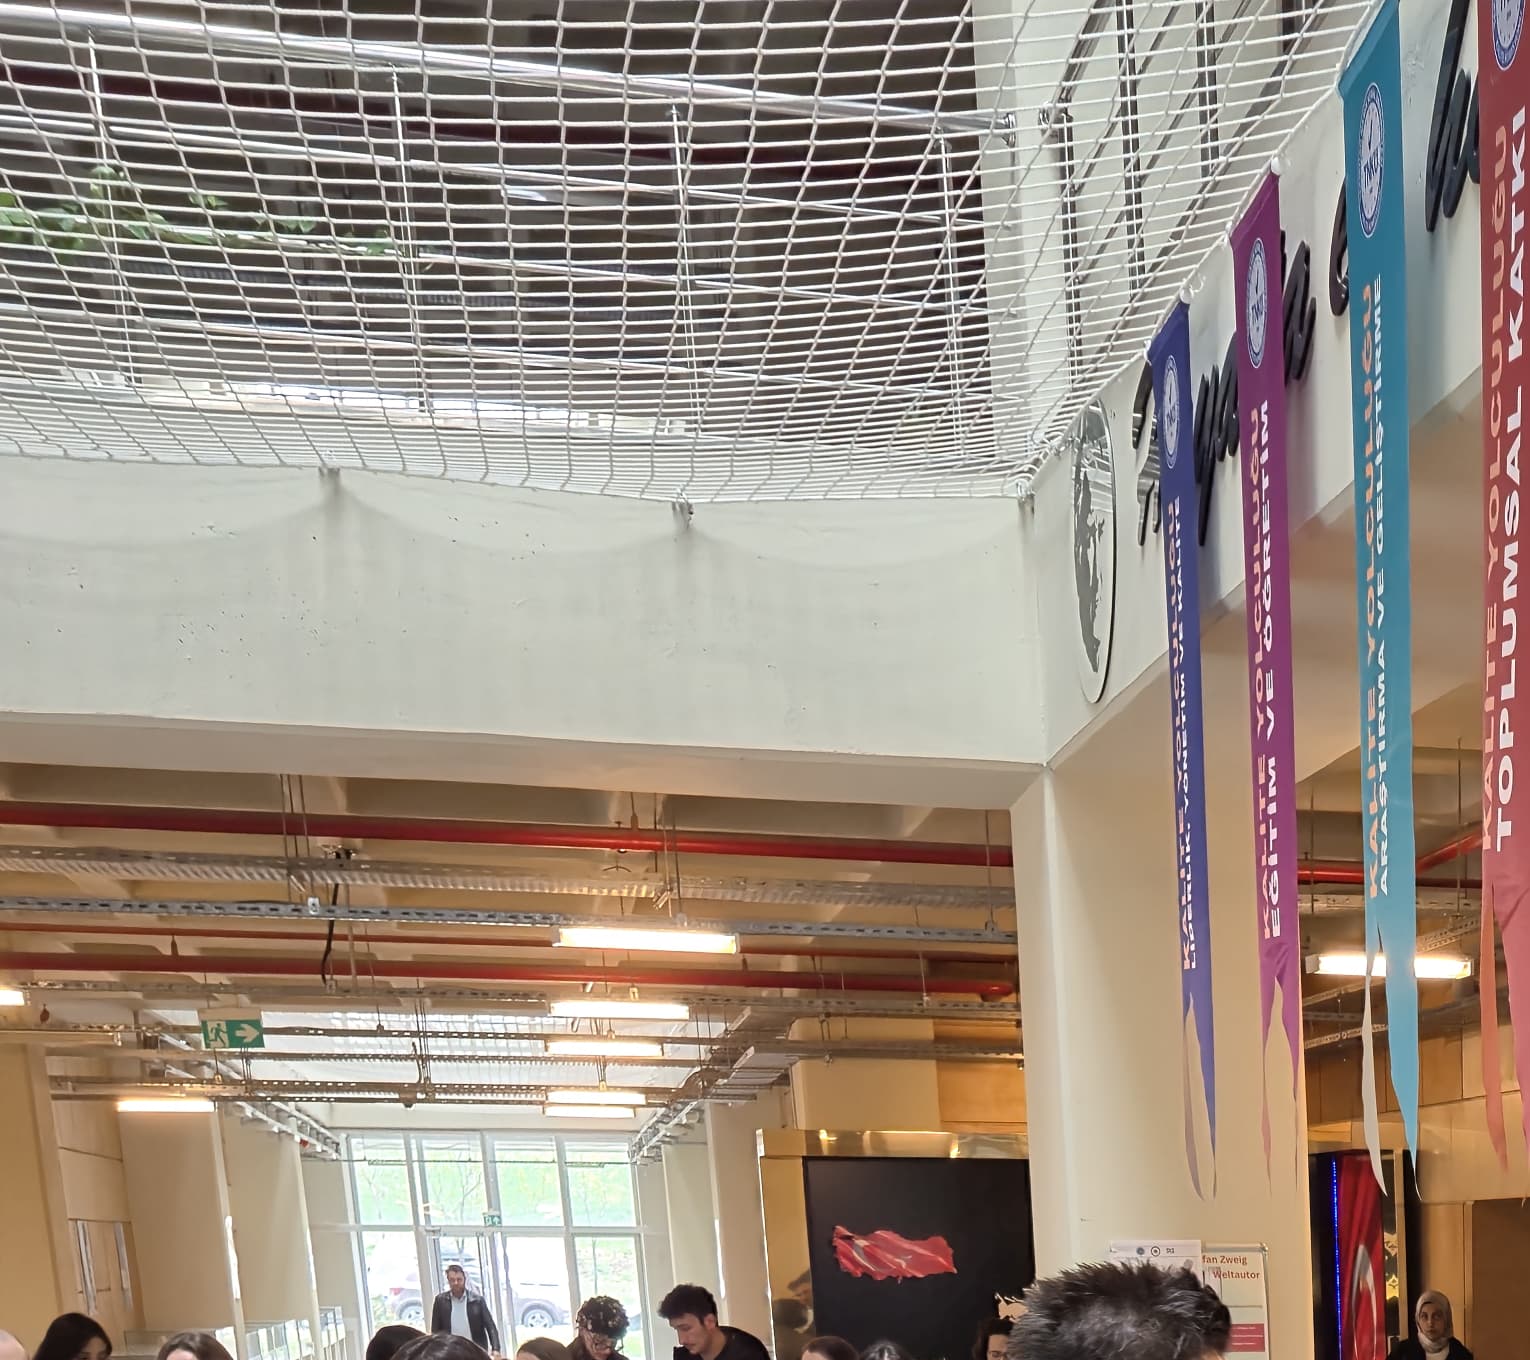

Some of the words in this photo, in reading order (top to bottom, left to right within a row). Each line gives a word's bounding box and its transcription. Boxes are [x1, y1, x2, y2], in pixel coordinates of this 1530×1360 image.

[1508, 105, 1526, 363] KATKI
[1487, 126, 1506, 580] YOLCULUĞU
[1260, 400, 1272, 652] ÖĞRETİM
[1377, 568, 1385, 630] VE
[1266, 669, 1274, 741] VE
[1496, 385, 1522, 852] TOPLUMSAL
[1267, 756, 1280, 938] EĞİTİM
[1212, 1270, 1260, 1279] Weltautor
[1219, 1255, 1248, 1266] Zweig
